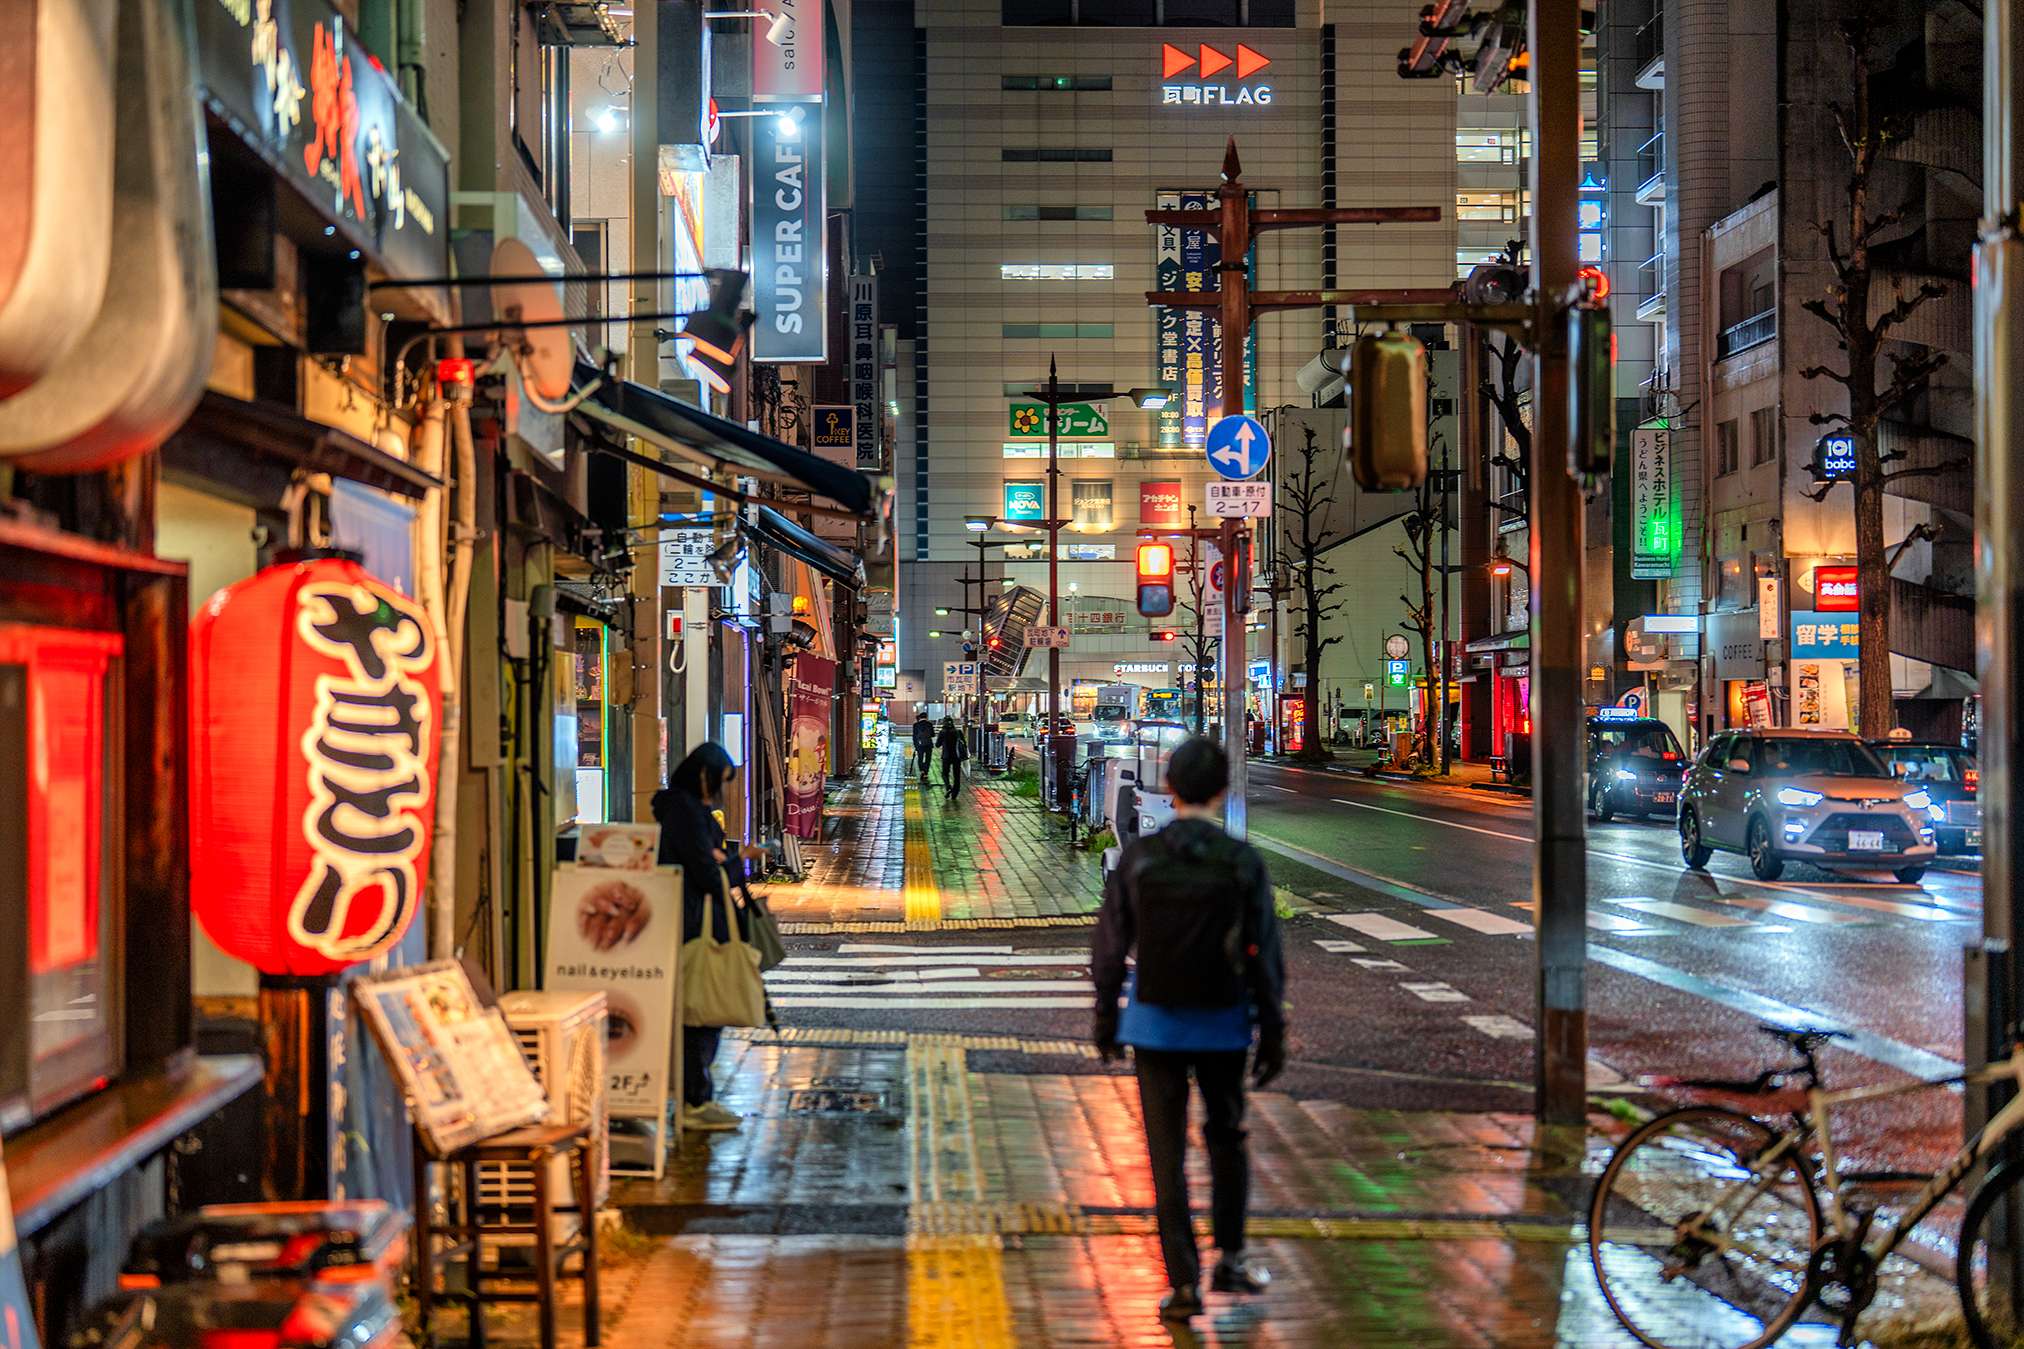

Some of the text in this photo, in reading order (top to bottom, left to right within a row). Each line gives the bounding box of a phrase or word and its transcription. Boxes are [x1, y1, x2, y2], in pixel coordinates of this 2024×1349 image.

[781, 28, 795, 70] salo
[1162, 85, 1272, 105] 瓦町FLAG
[775, 220, 802, 335] SUPER
[1162, 271, 1178, 381] ジク堂書店
[1185, 271, 1203, 417] 安定×高価買取
[855, 283, 874, 460] 川原耳鼻咽喉科医院
[816, 435, 850, 444] COFFEE
[1210, 486, 1266, 498] 自動車・原付
[1009, 500, 1040, 510] NOVA
[1215, 501, 1261, 513] 2-17
[1796, 624, 1838, 646] 留学
[1722, 644, 1752, 660] COFFEE
[1113, 664, 1218, 673] STARBUCK COFE
[1392, 662, 1403, 672] P
[1628, 696, 1638, 708] P
[556, 962, 664, 982] nail&eyelash
[610, 1075, 634, 1091] 2F
